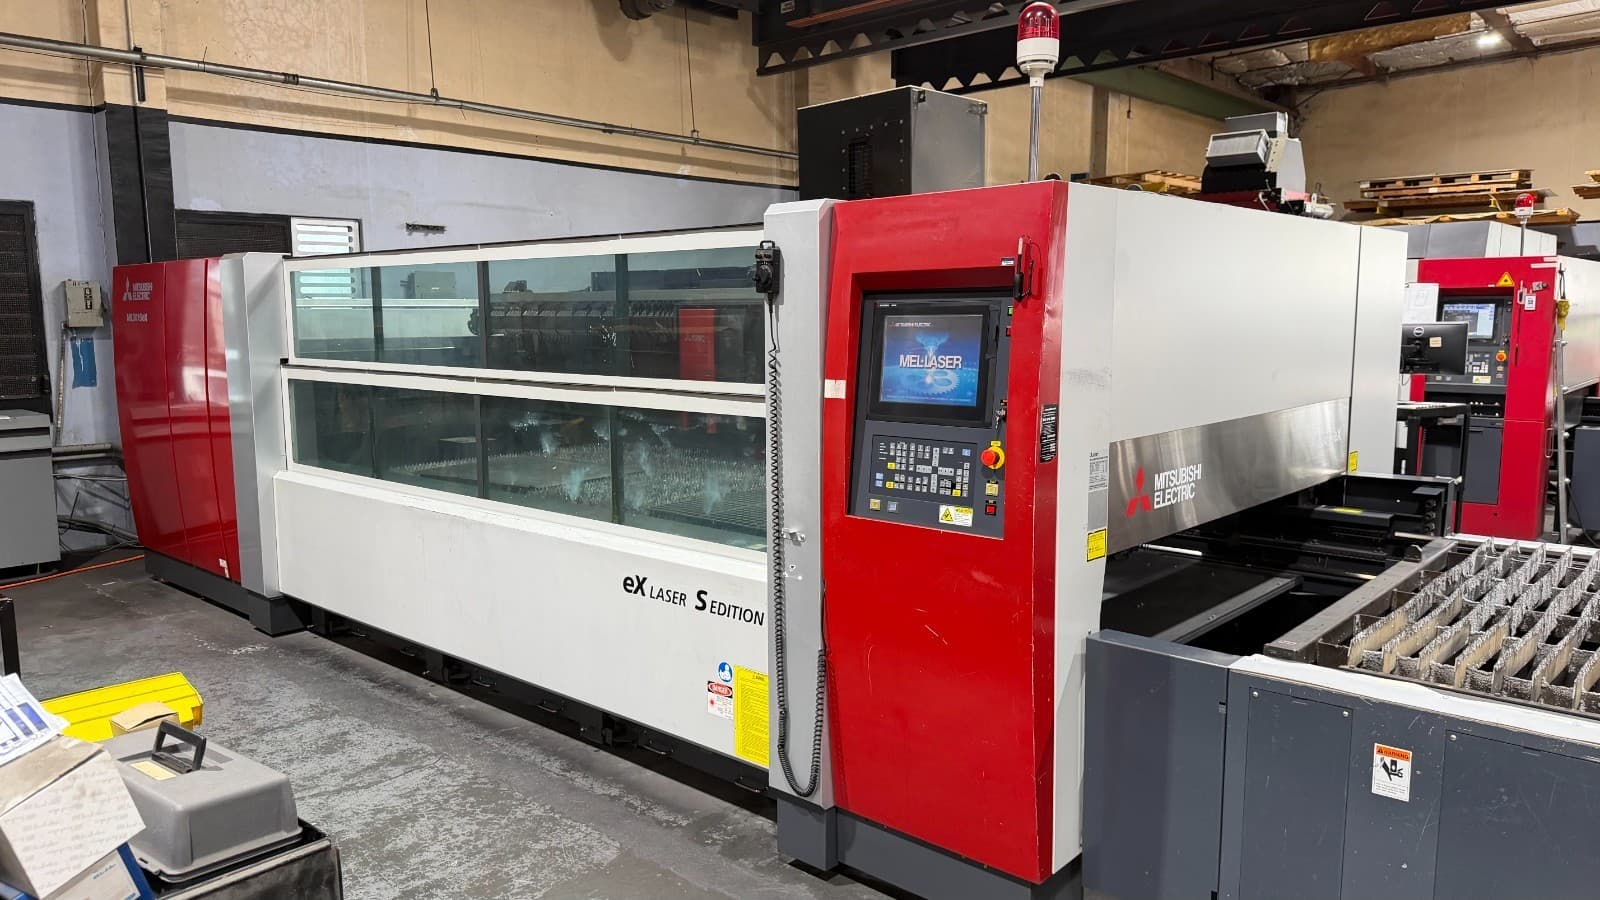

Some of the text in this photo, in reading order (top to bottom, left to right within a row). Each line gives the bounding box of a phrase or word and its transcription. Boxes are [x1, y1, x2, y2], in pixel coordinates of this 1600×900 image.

[1154, 463, 1202, 491] MITSUBISHI
[1153, 483, 1196, 509] ELECTRIC
[622, 574, 765, 626] eX LASER S EDITION
